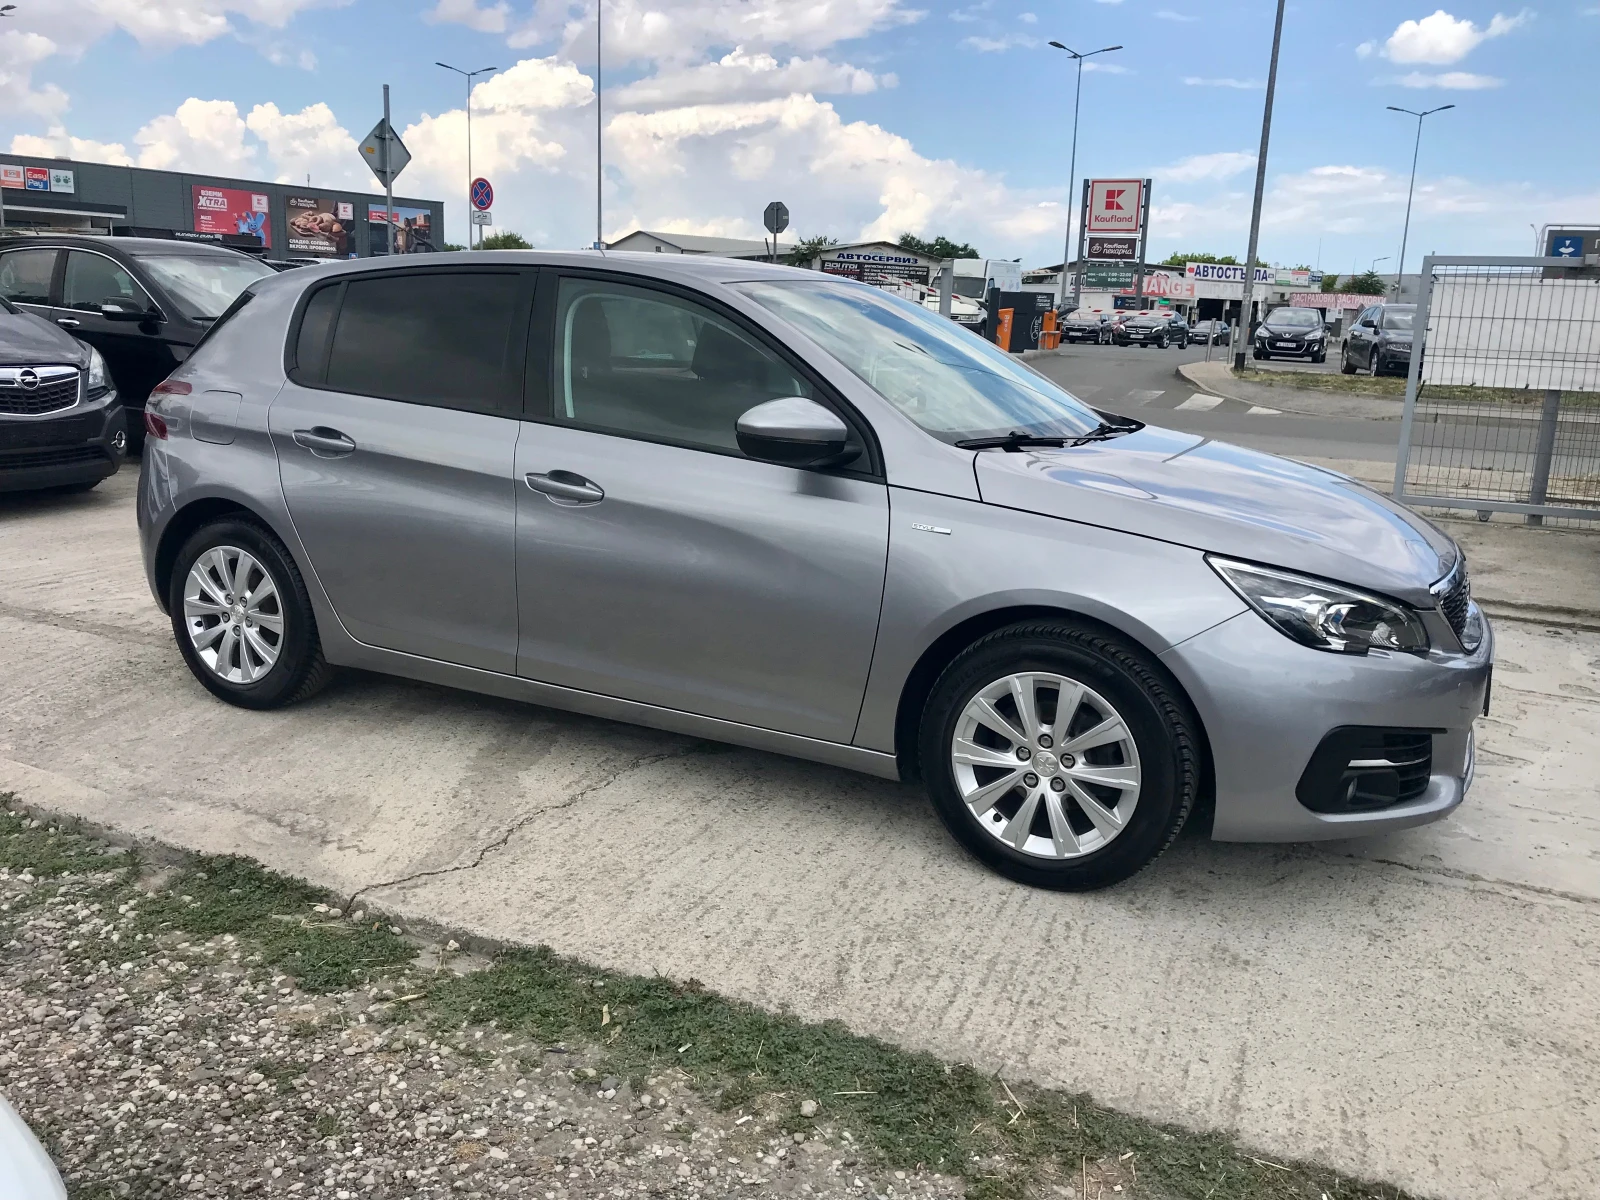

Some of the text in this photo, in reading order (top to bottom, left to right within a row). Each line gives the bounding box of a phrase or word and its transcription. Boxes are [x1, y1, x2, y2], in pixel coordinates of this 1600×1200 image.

[27, 171, 47, 180] Easy
[28, 179, 44, 189] Pay
[198, 196, 227, 208] XTRA
[1094, 214, 1133, 222] Kaufland
[837, 253, 919, 264] АВТОСЕРВИЗ
[1194, 264, 1268, 281] АВТОСТЪЛА
[1126, 277, 1191, 296] HANGE
[1292, 294, 1386, 305] ЗАСТРАХОВКИ ЗАСТРАХОВКИ
